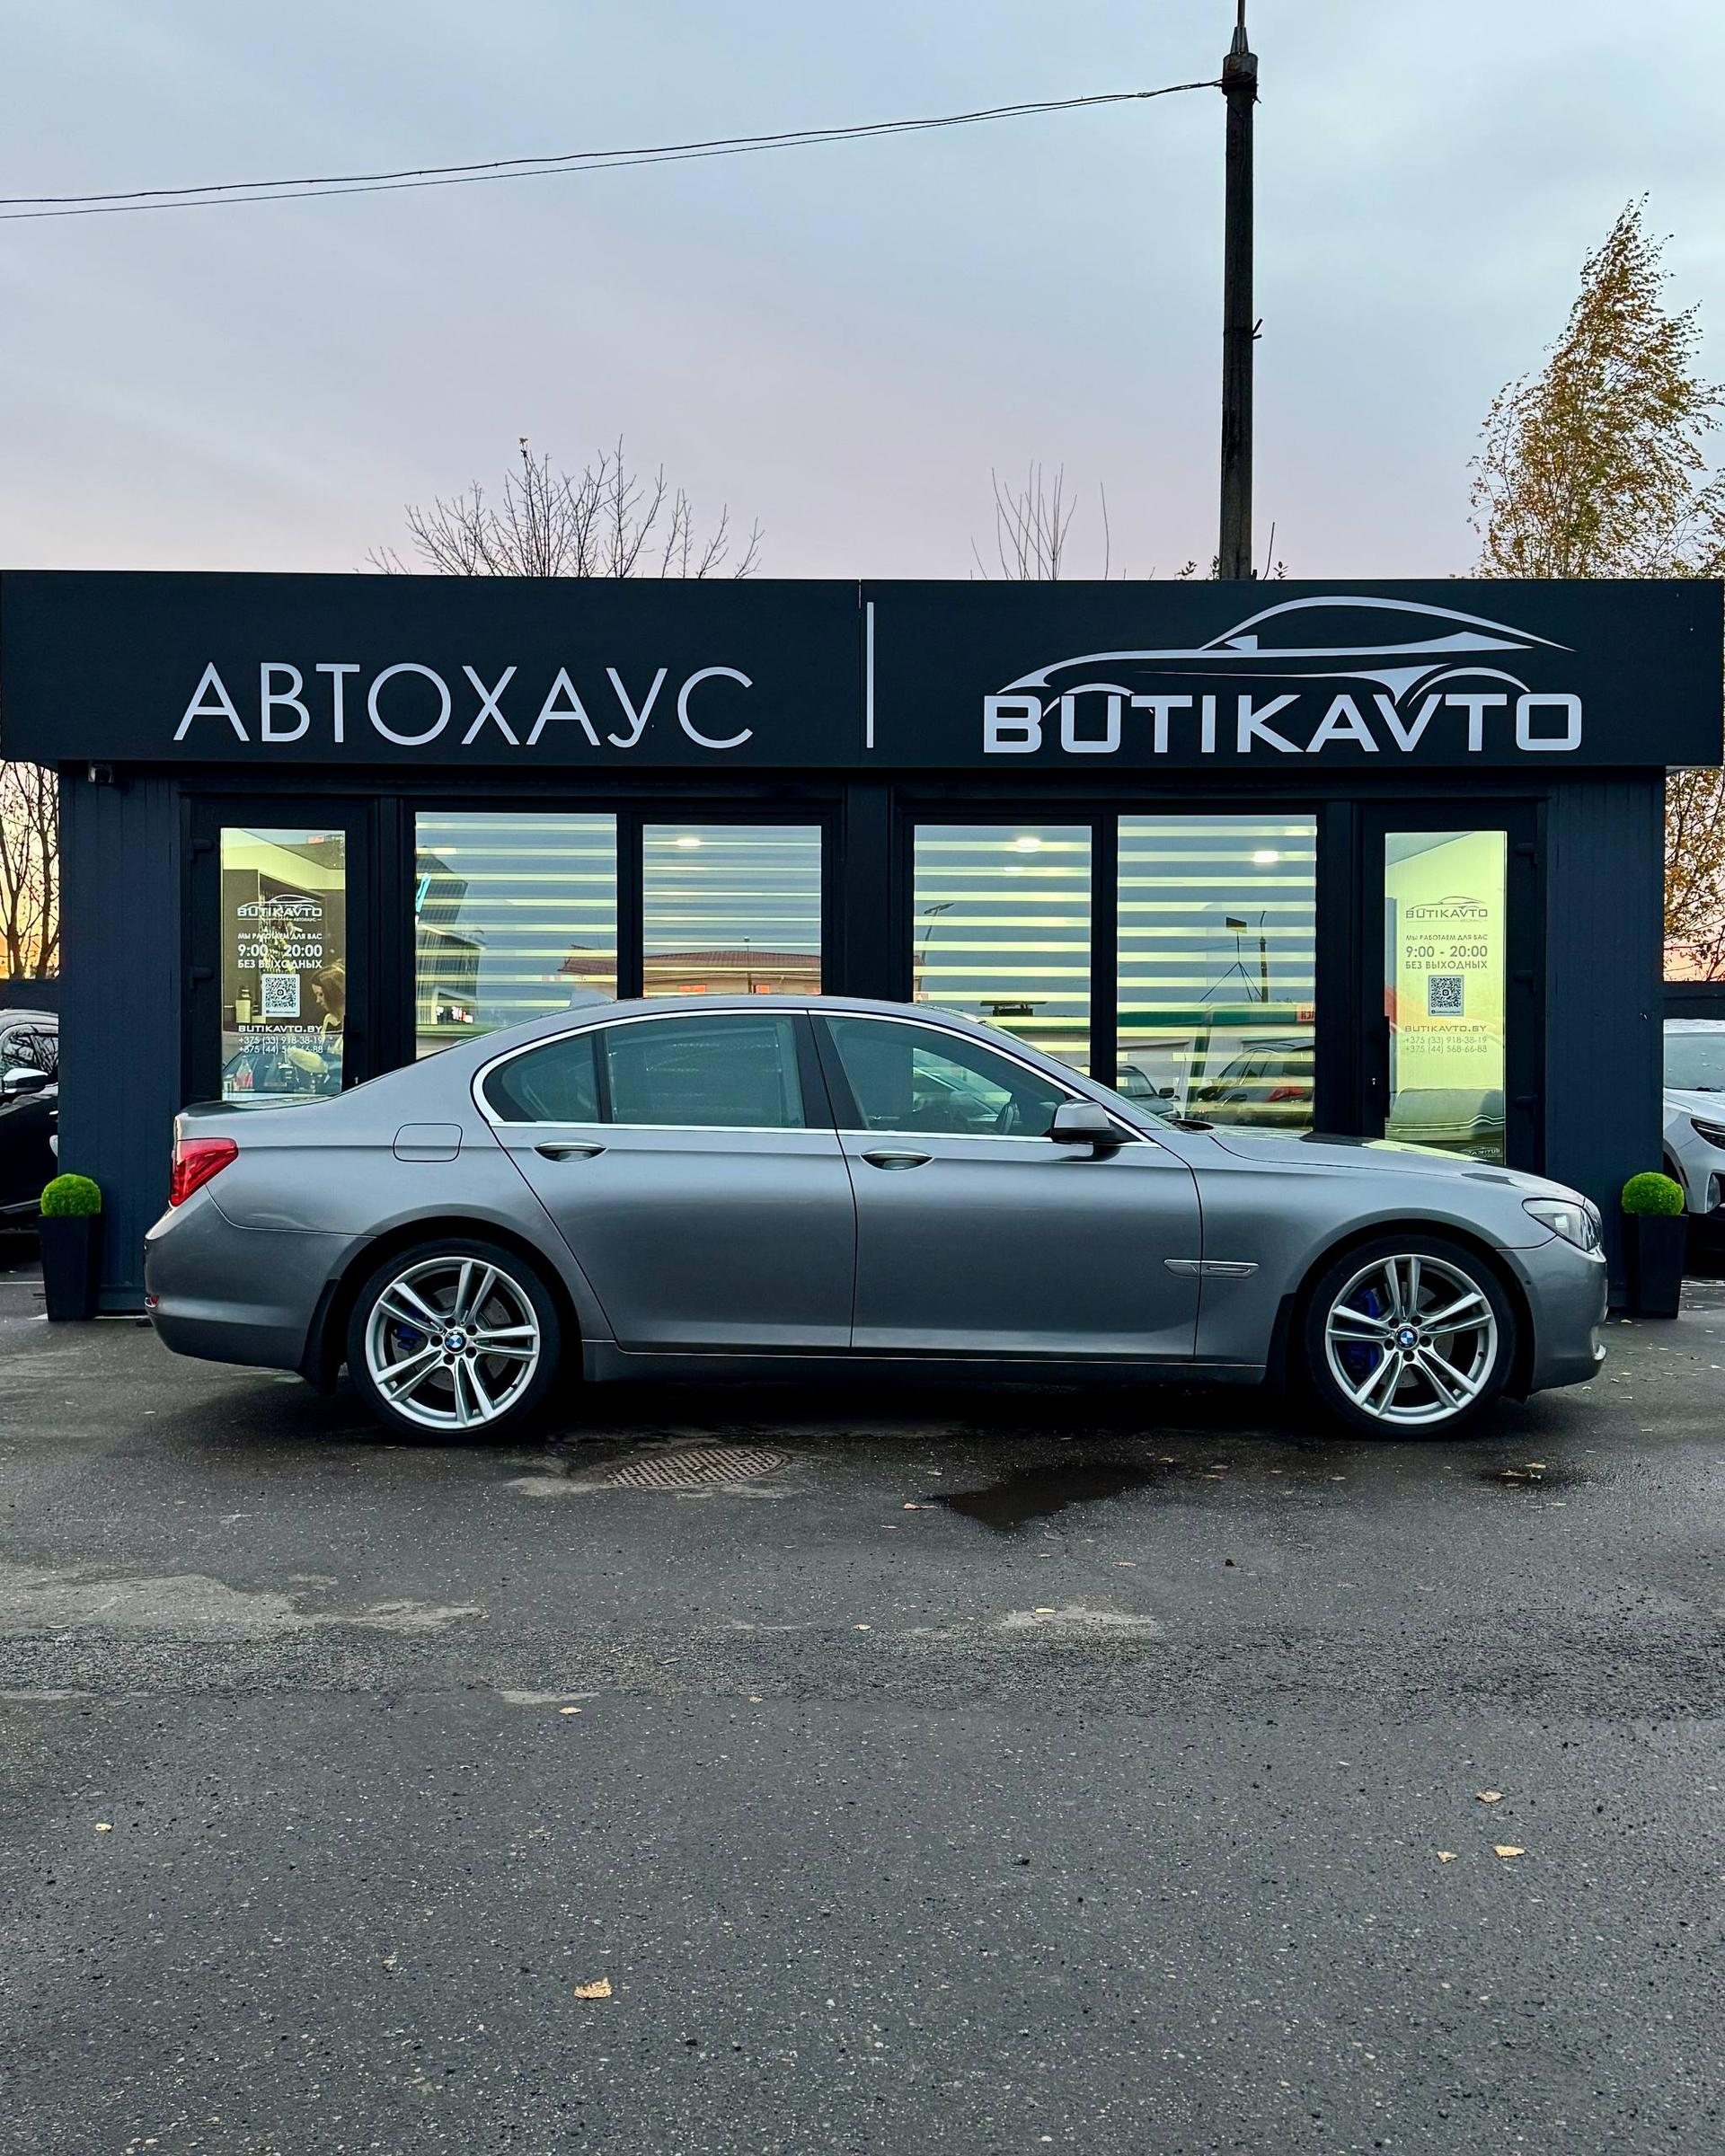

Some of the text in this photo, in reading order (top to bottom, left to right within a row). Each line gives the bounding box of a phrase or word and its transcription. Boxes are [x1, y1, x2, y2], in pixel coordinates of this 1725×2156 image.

[172, 661, 754, 748] АВТОХАУС
[984, 693, 1582, 754] BUTIKAVTO
[237, 907, 323, 916] BUTIKAVTO
[1405, 908, 1488, 918] BUTIKAVTO
[238, 944, 269, 957] 9:00
[283, 944, 323, 957] 20:00
[1406, 946, 1435, 958] 9:00
[1450, 946, 1488, 958] 20:00
[238, 959, 323, 969] БЕЗ ВЫХОДНЫХ
[1406, 960, 1488, 969] БЕЗ ВЫХОДНЫХ
[238, 1036, 261, 1044] +375
[262, 1036, 279, 1046] (33)
[1405, 1036, 1425, 1044] +375
[1429, 1036, 1444, 1045] (33)
[262, 1045, 279, 1055] (44)
[1405, 1045, 1425, 1053] +375
[1429, 1045, 1444, 1054] (44)
